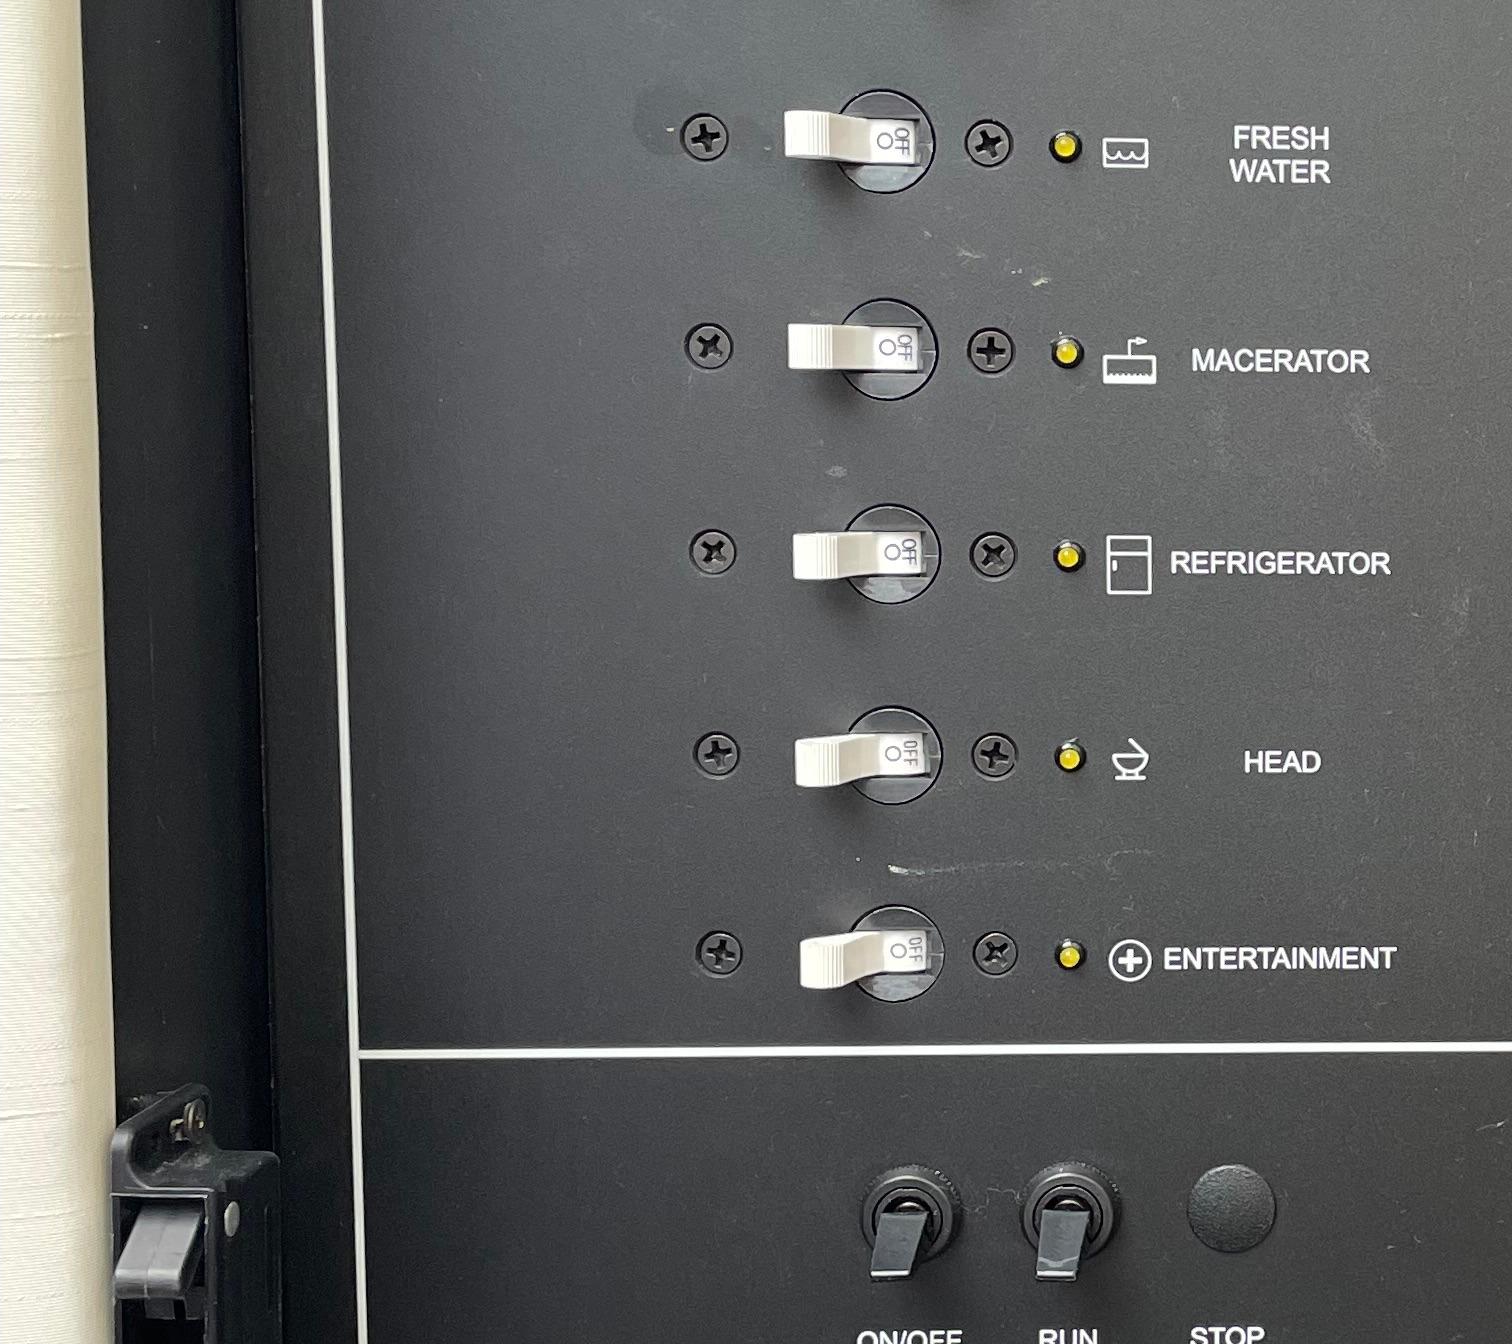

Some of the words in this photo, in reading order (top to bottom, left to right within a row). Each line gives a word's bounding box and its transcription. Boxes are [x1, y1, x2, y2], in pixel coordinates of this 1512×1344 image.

[1233, 124, 1330, 151] FRESH
[1229, 158, 1331, 184] WATER
[1191, 347, 1371, 374] MACERATOR
[1170, 550, 1392, 576] REFRIGERATOR
[1244, 750, 1322, 774] HEAD
[1163, 946, 1398, 970] ENTERTAINMENT
